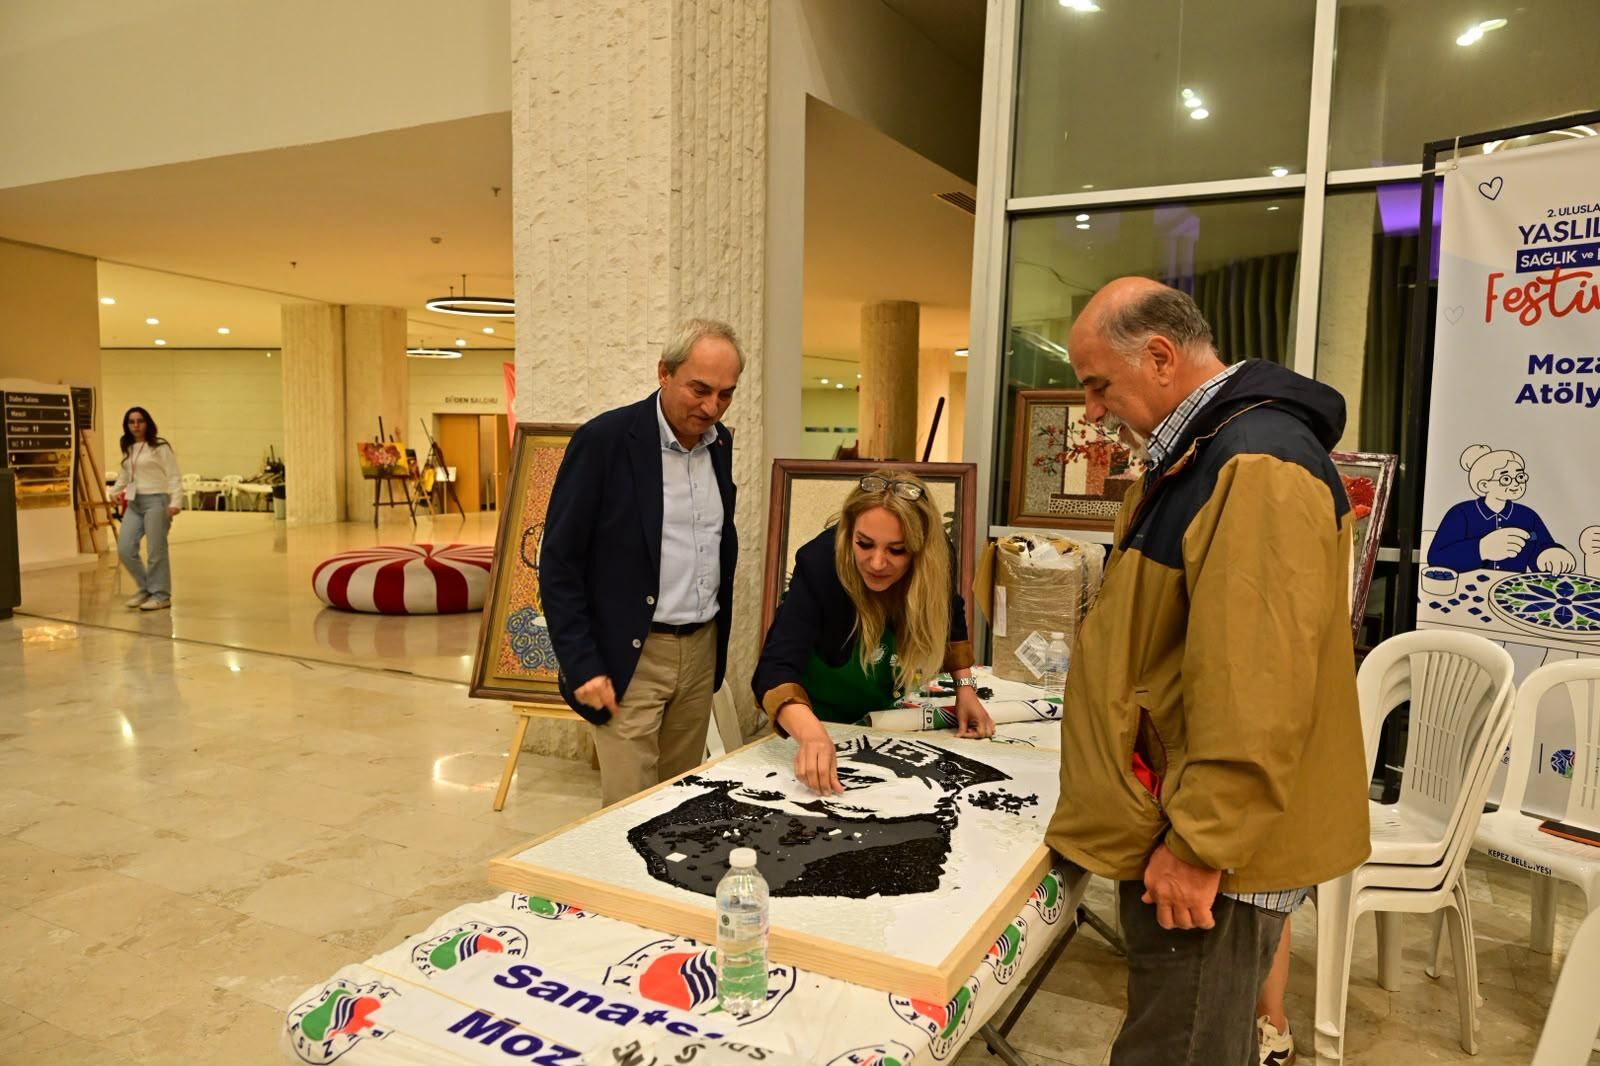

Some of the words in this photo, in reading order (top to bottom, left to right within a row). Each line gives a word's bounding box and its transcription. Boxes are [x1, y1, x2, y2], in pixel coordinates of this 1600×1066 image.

[1547, 209, 1557, 218] 2.
[1520, 250, 1578, 268] SAĞLIK
[1581, 252, 1594, 260] ve
[1488, 848, 1509, 862] KEPEZ
